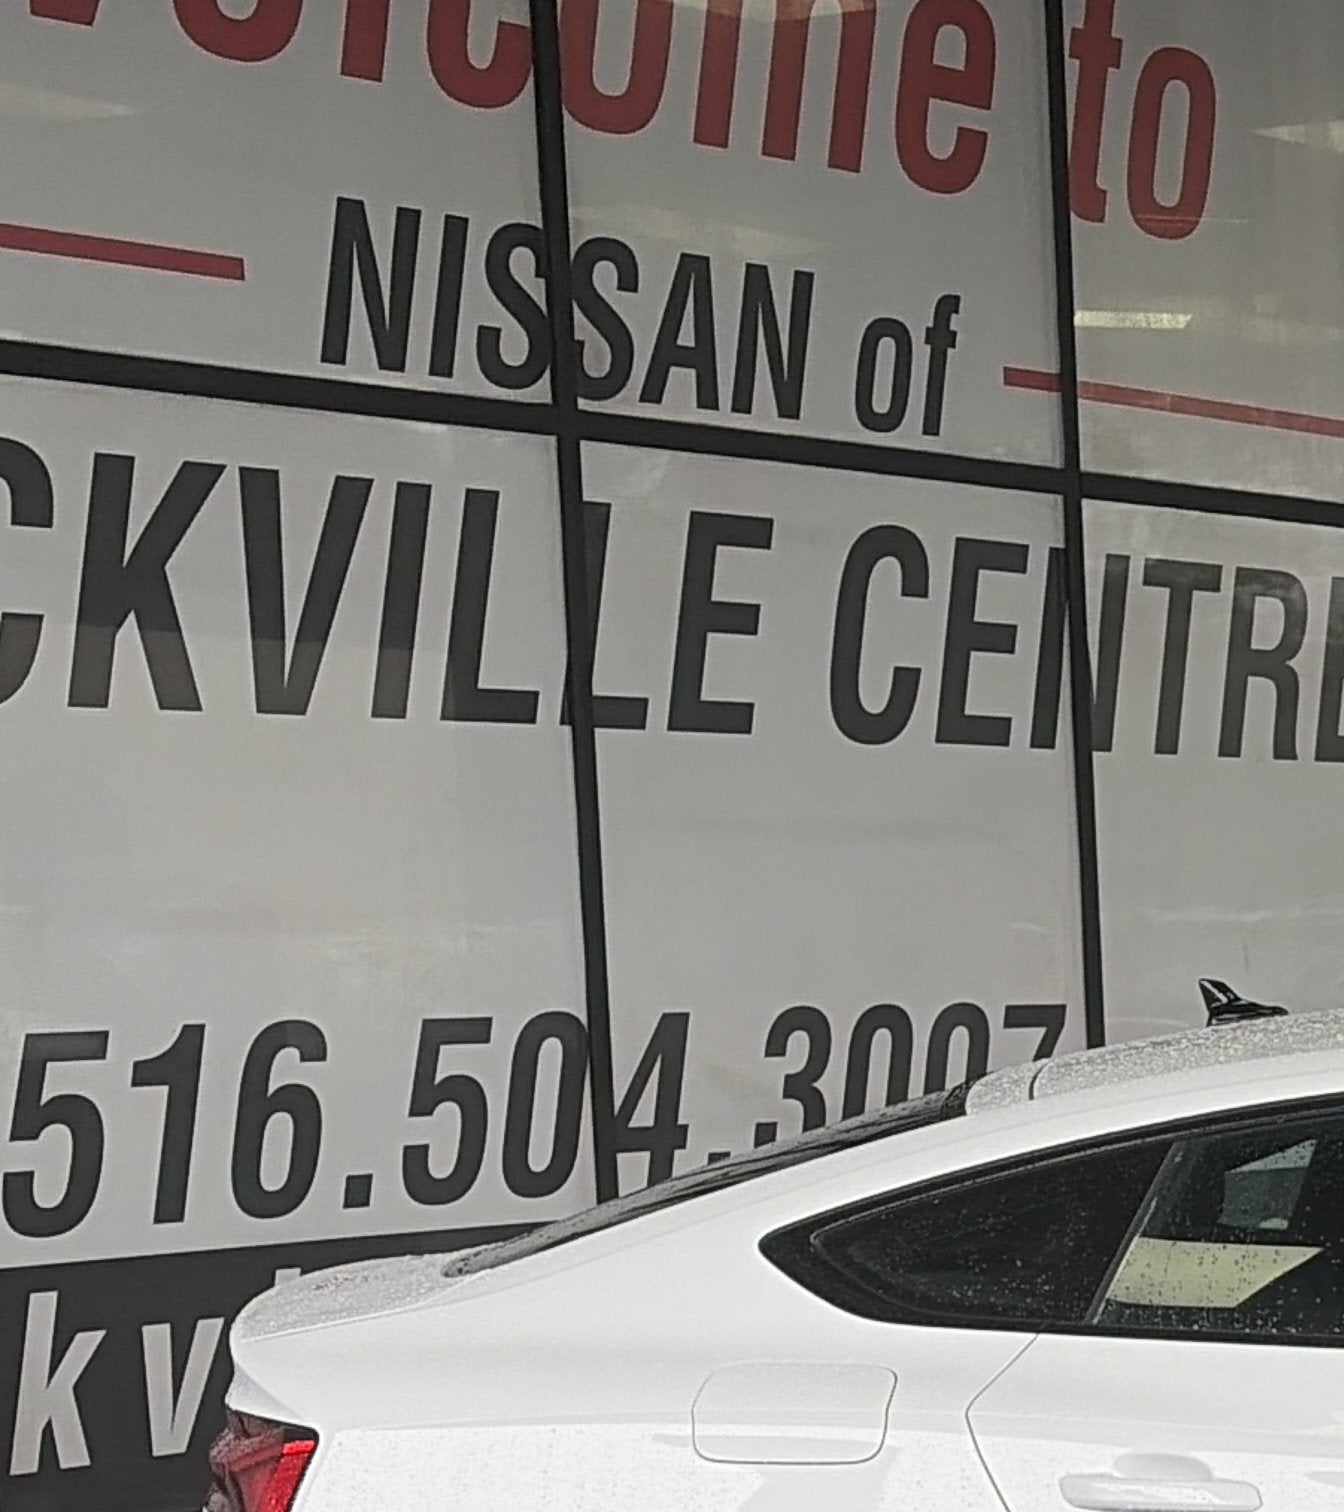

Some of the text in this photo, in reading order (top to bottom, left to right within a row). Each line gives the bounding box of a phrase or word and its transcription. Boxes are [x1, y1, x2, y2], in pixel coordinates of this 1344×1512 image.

[1067, 0, 1216, 240] to
[320, 196, 961, 437] NISSAN of
